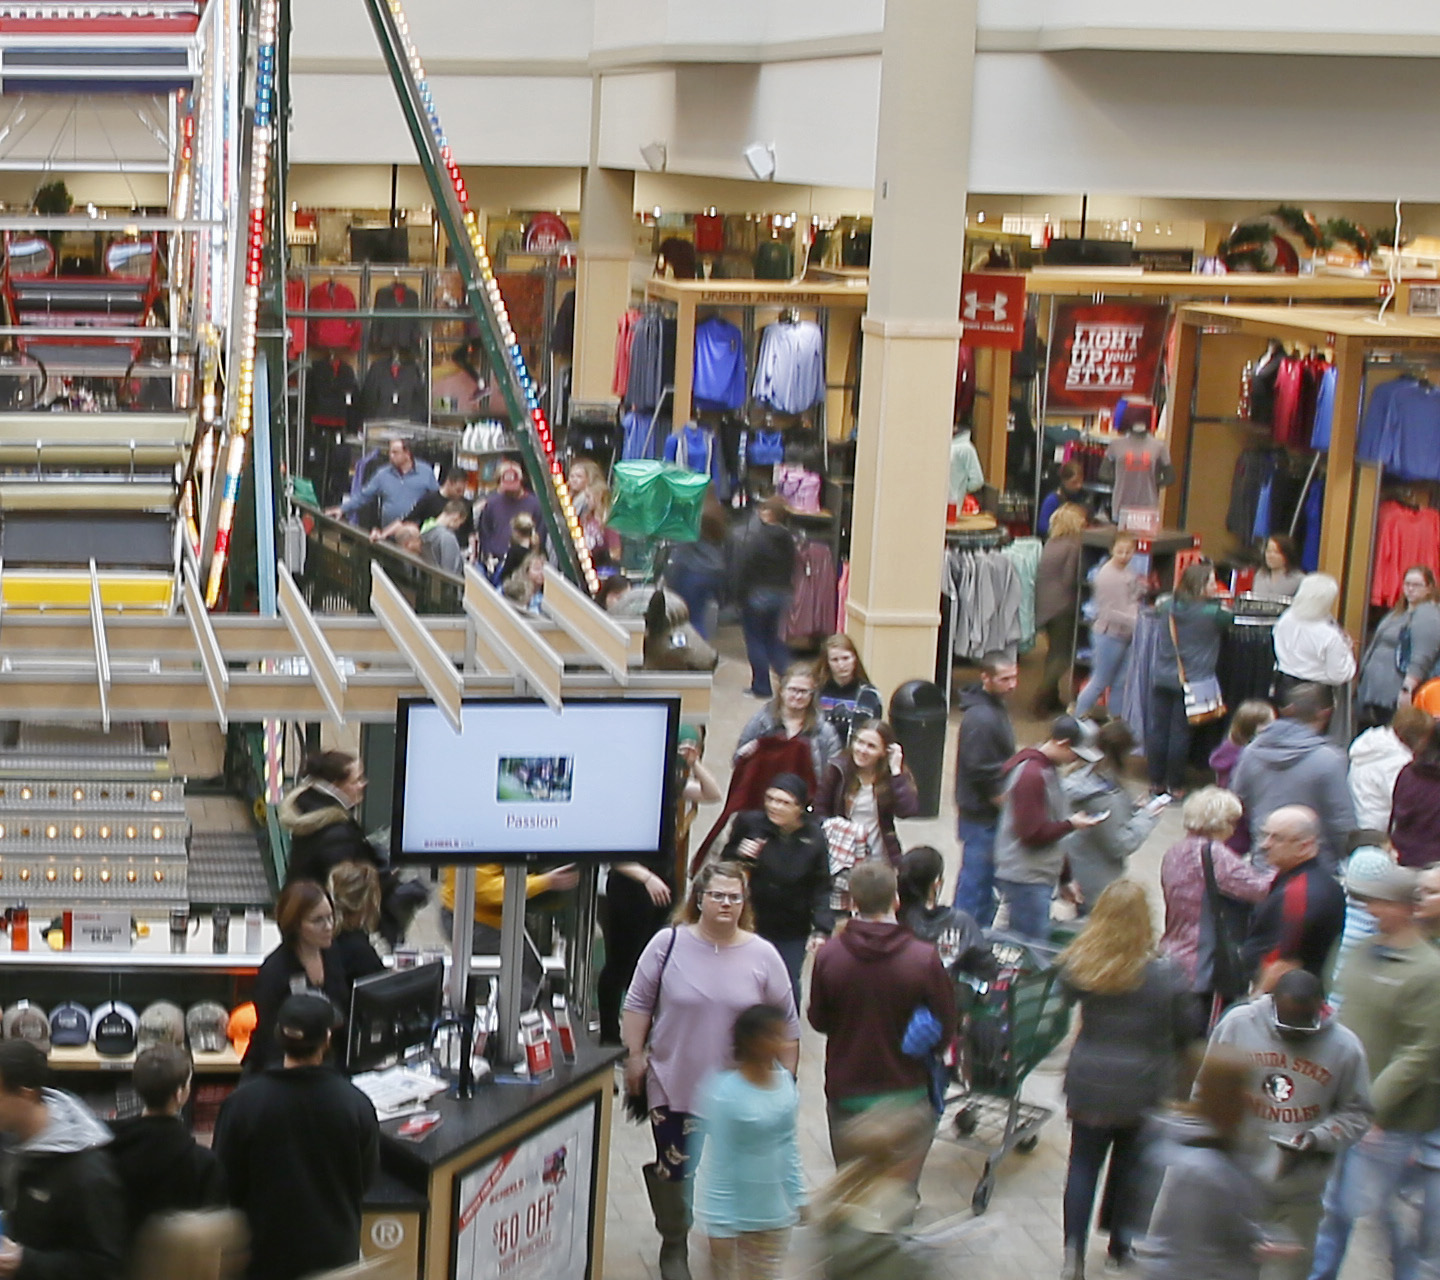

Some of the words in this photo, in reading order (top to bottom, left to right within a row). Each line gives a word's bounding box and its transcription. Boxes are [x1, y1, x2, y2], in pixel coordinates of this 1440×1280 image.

[700, 291, 752, 303] UNDER
[756, 291, 820, 304] ARMOUR
[1073, 330, 1142, 352] LIGHT
[1071, 350, 1104, 367] UP
[1104, 351, 1137, 370] your
[1066, 366, 1135, 385] STYLE
[506, 813, 559, 829] Passion
[1292, 1056, 1333, 1087] STATE
[492, 1210, 520, 1256] $50
[526, 1193, 554, 1240] OFF
